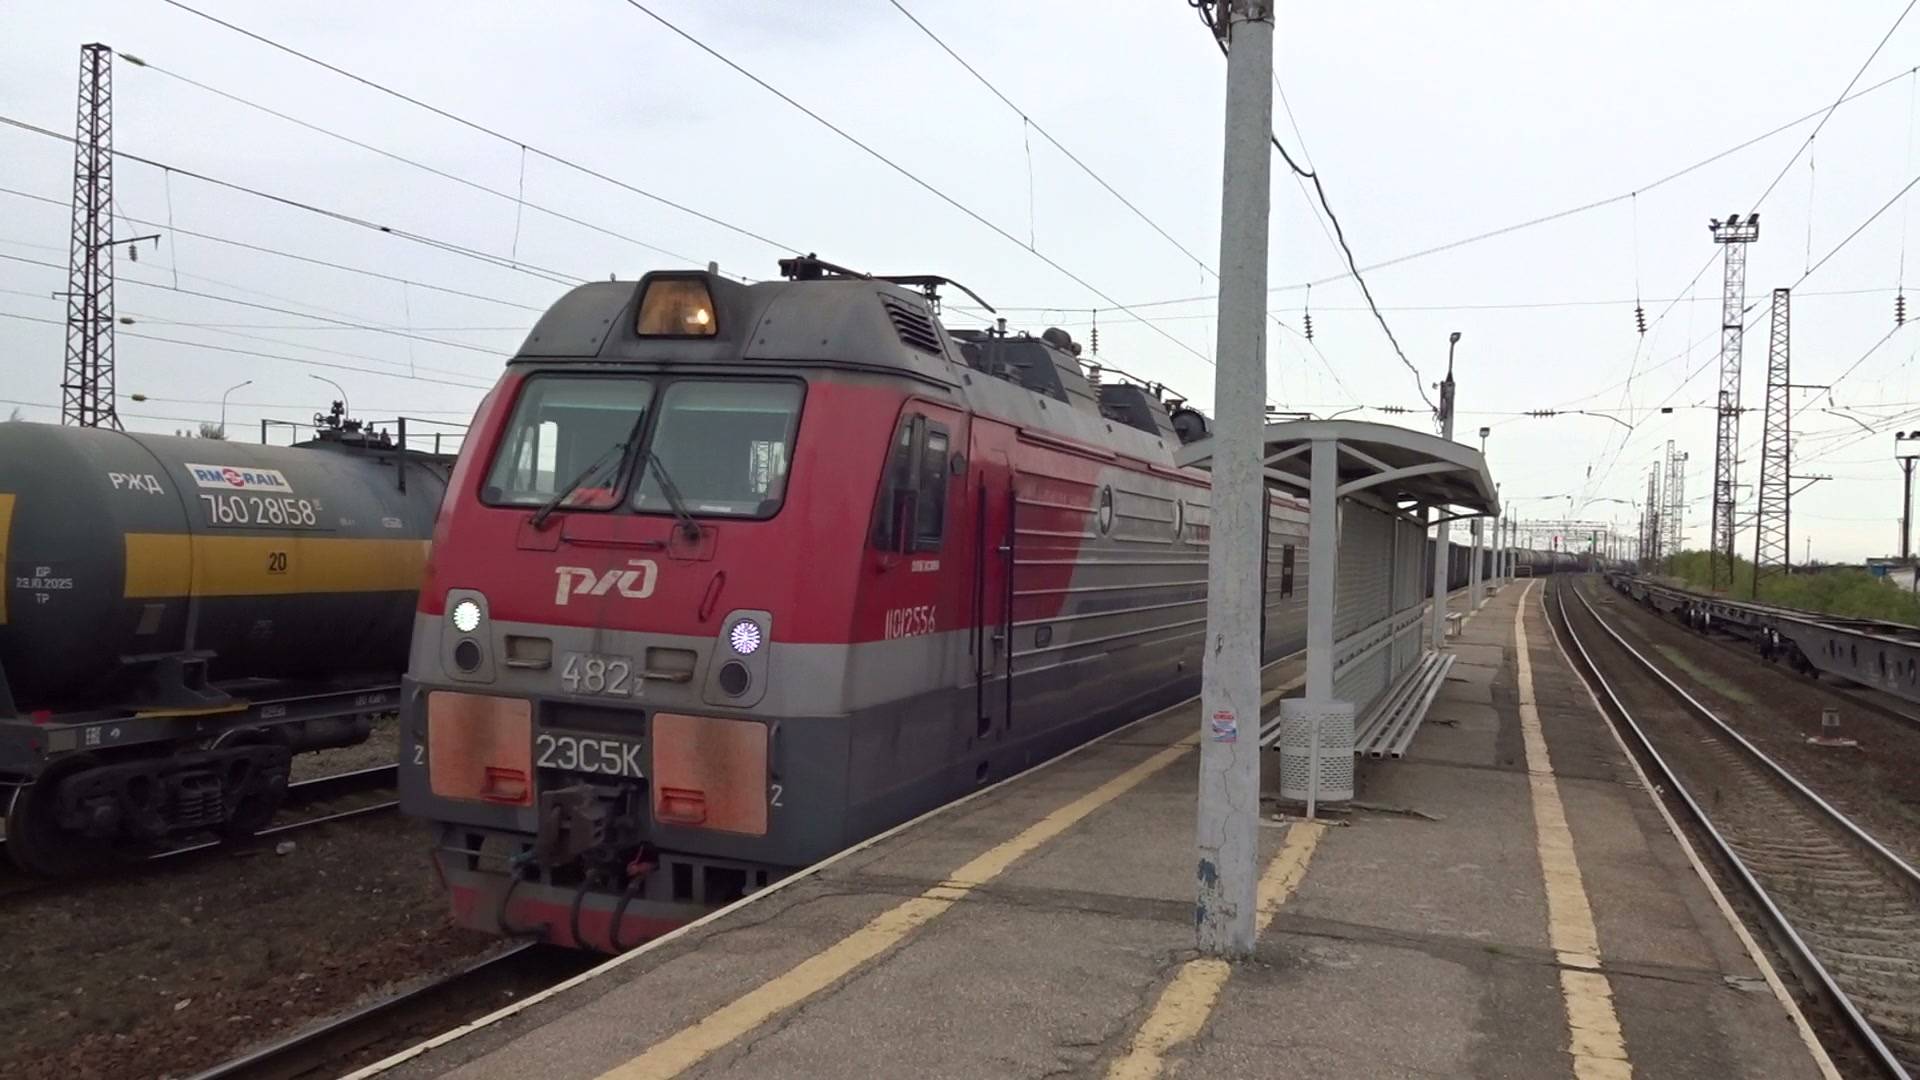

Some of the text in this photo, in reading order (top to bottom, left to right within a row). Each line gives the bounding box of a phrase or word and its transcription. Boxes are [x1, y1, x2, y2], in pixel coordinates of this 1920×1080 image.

[108, 472, 165, 495] РЖД
[242, 473, 286, 487] RAIL
[269, 551, 287, 572] 20
[561, 656, 629, 695] 482
[413, 744, 425, 766] 2
[536, 734, 645, 778] 2ЭС5К
[770, 784, 784, 807] 2
